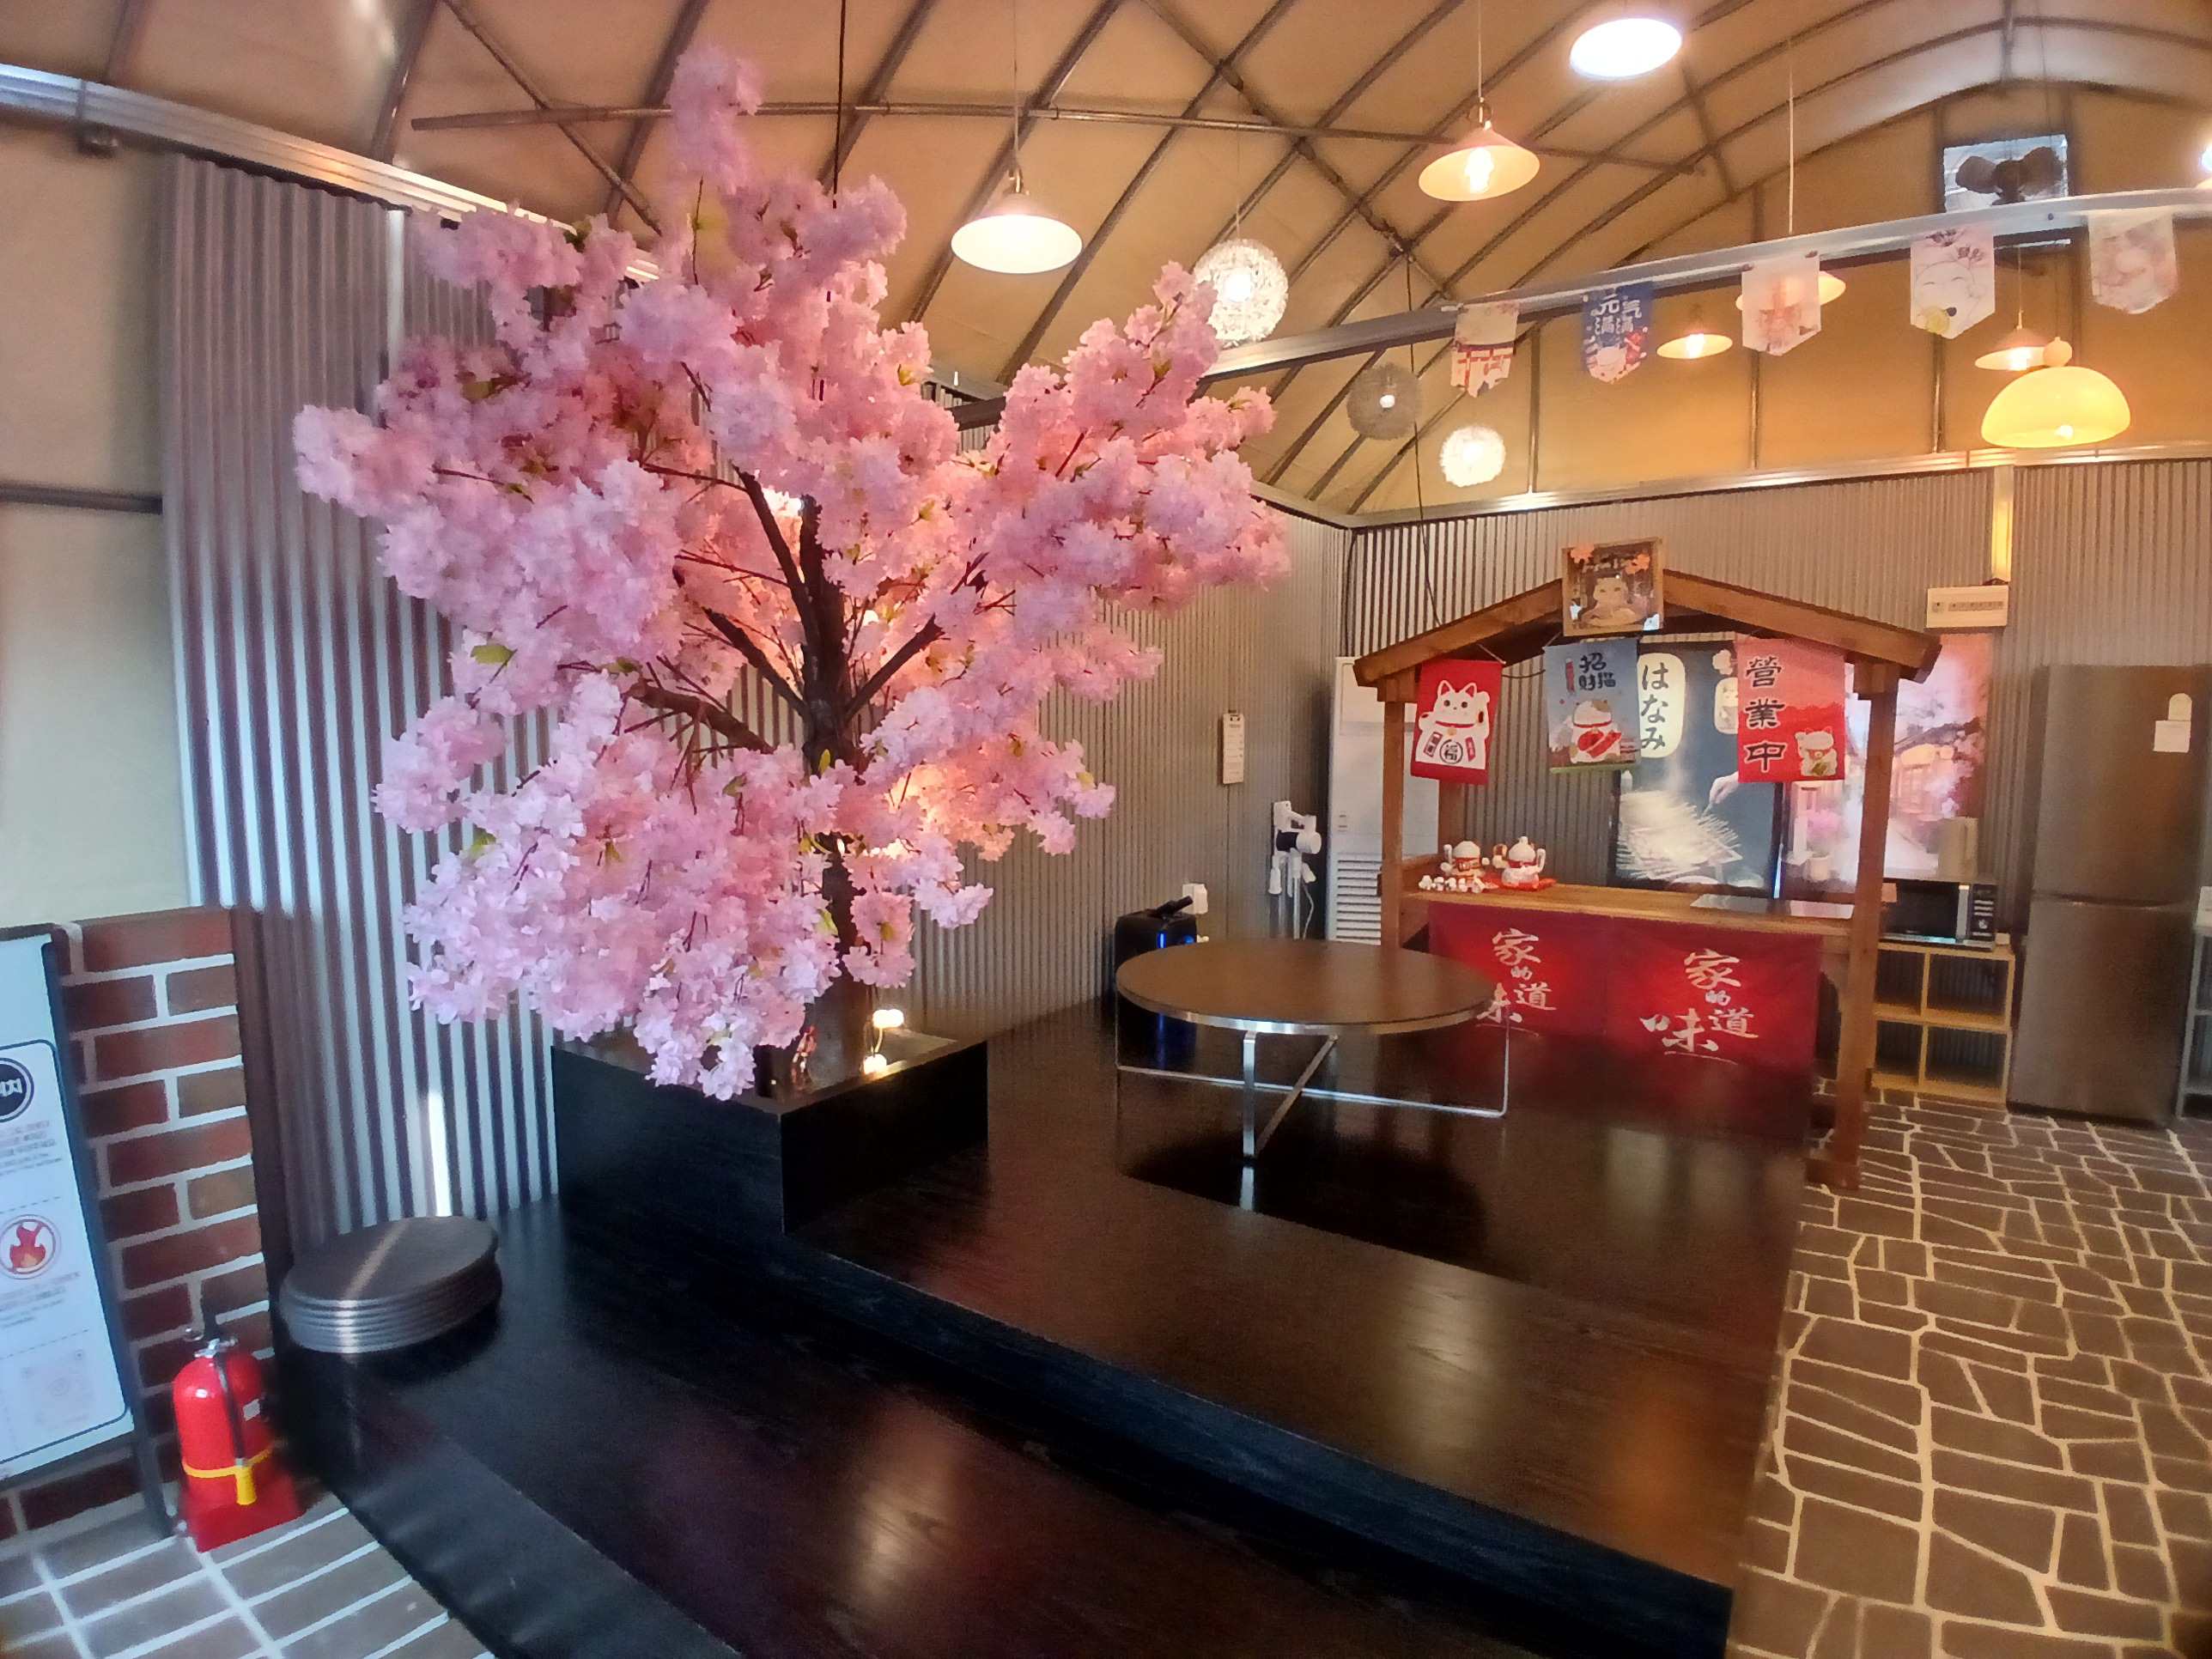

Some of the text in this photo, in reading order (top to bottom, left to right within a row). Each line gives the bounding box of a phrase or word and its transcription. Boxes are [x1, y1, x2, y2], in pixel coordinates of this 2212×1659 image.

[1578, 652, 1607, 672] 招
[1641, 662, 1669, 750] はなみ
[1744, 656, 1787, 773] 營業中
